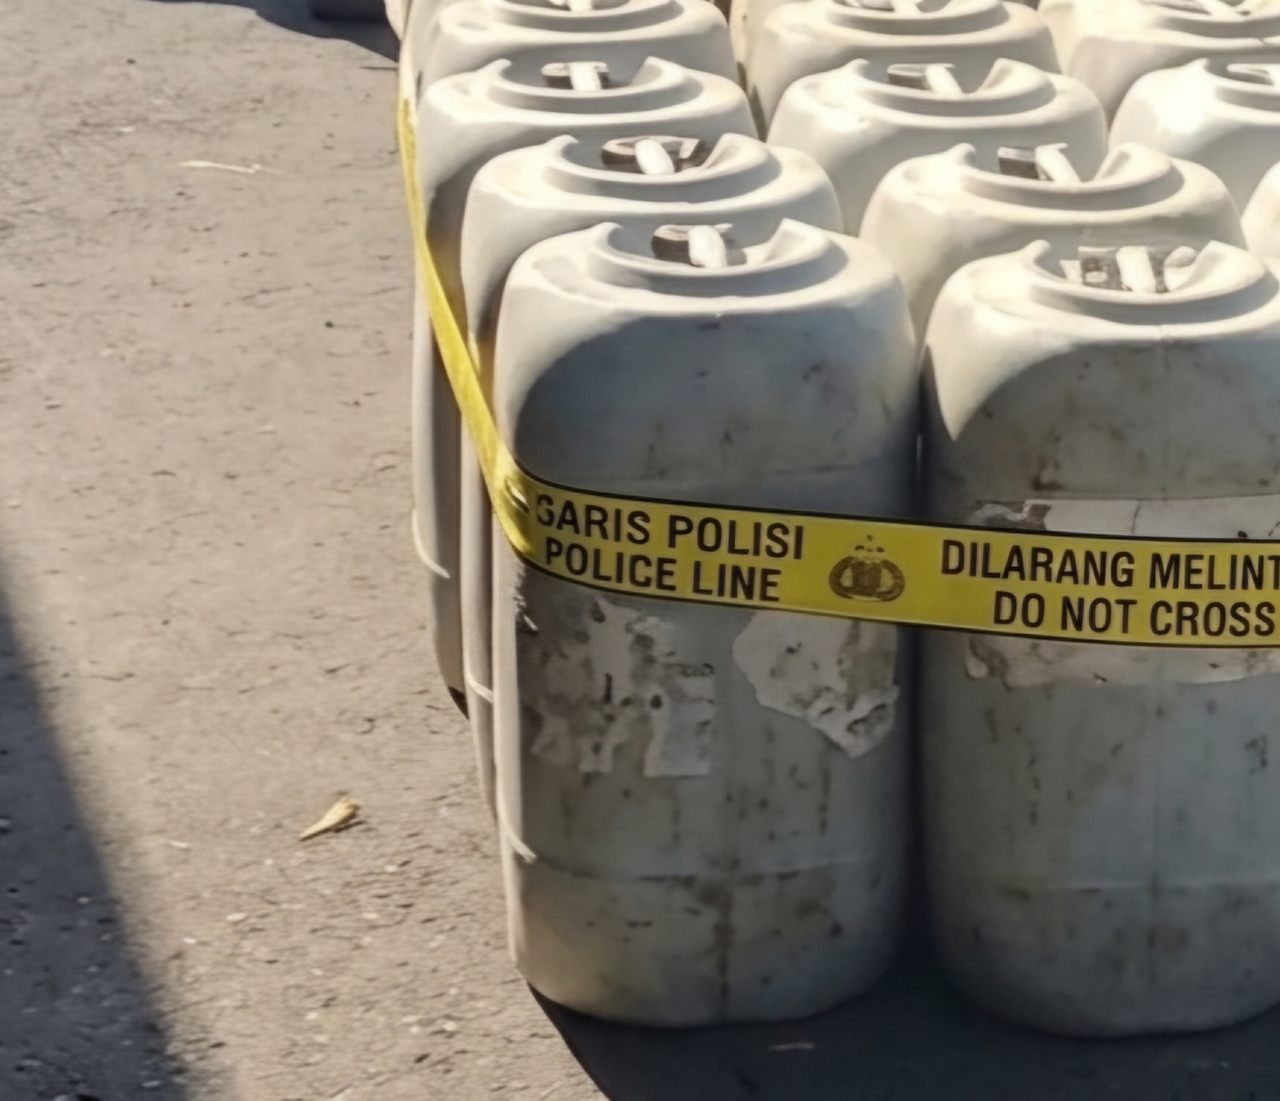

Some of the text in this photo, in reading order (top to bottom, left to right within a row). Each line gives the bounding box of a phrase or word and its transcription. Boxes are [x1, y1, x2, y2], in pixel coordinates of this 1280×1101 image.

[537, 494, 805, 560] GARIS POLISI
[546, 536, 783, 602] POLICE LINE
[941, 539, 1135, 588] DILARANG
[993, 590, 1276, 637] DO NOT CROSS
